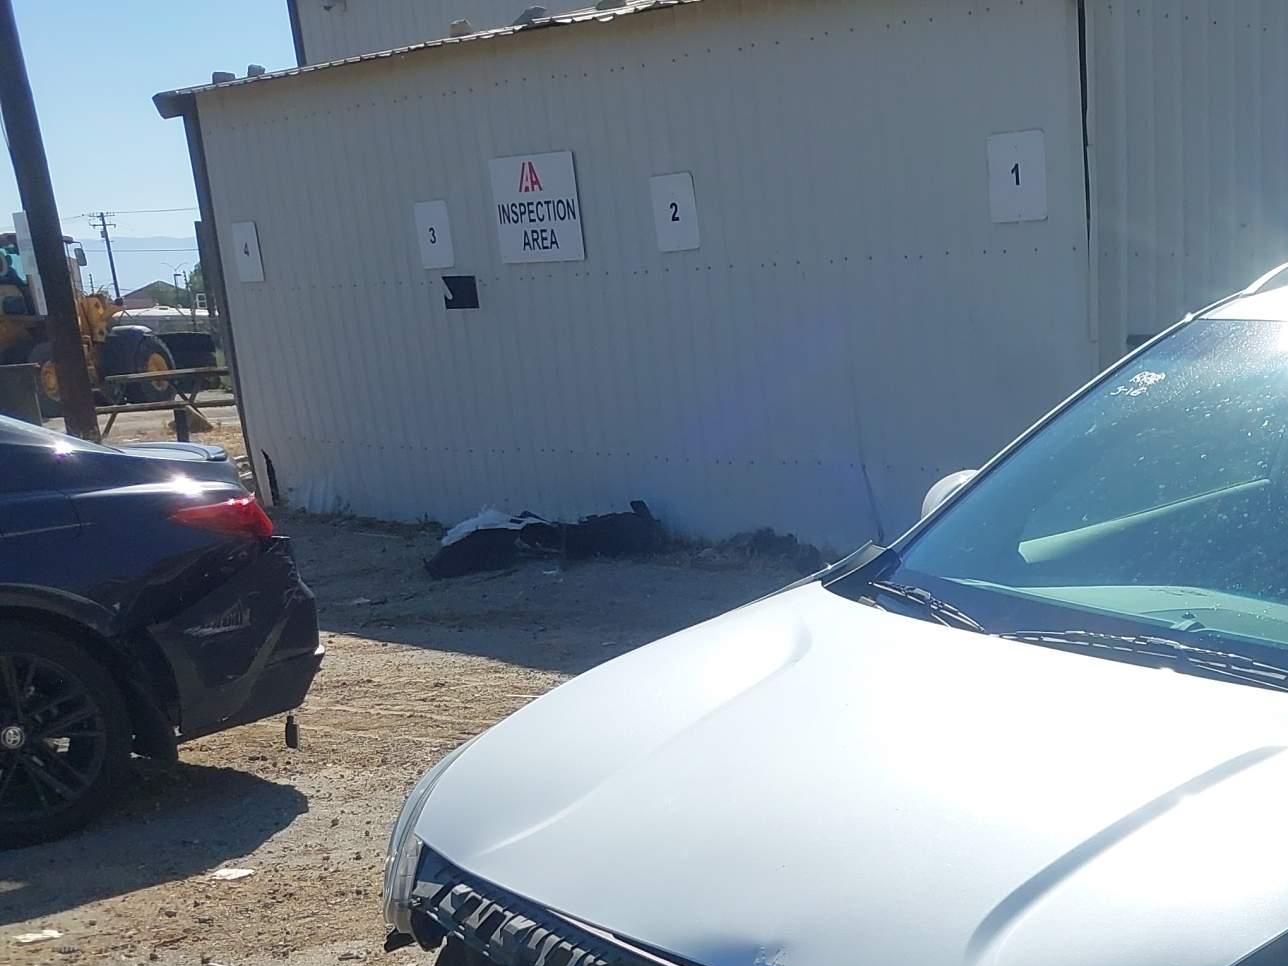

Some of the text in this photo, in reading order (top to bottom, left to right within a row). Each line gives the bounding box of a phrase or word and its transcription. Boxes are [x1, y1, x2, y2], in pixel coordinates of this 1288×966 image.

[1010, 163, 1020, 186] 1
[498, 199, 577, 225] INSPECTION
[669, 202, 680, 221] 2
[428, 227, 437, 244] 3
[523, 229, 560, 251] AREA
[243, 241, 250, 257] 4
